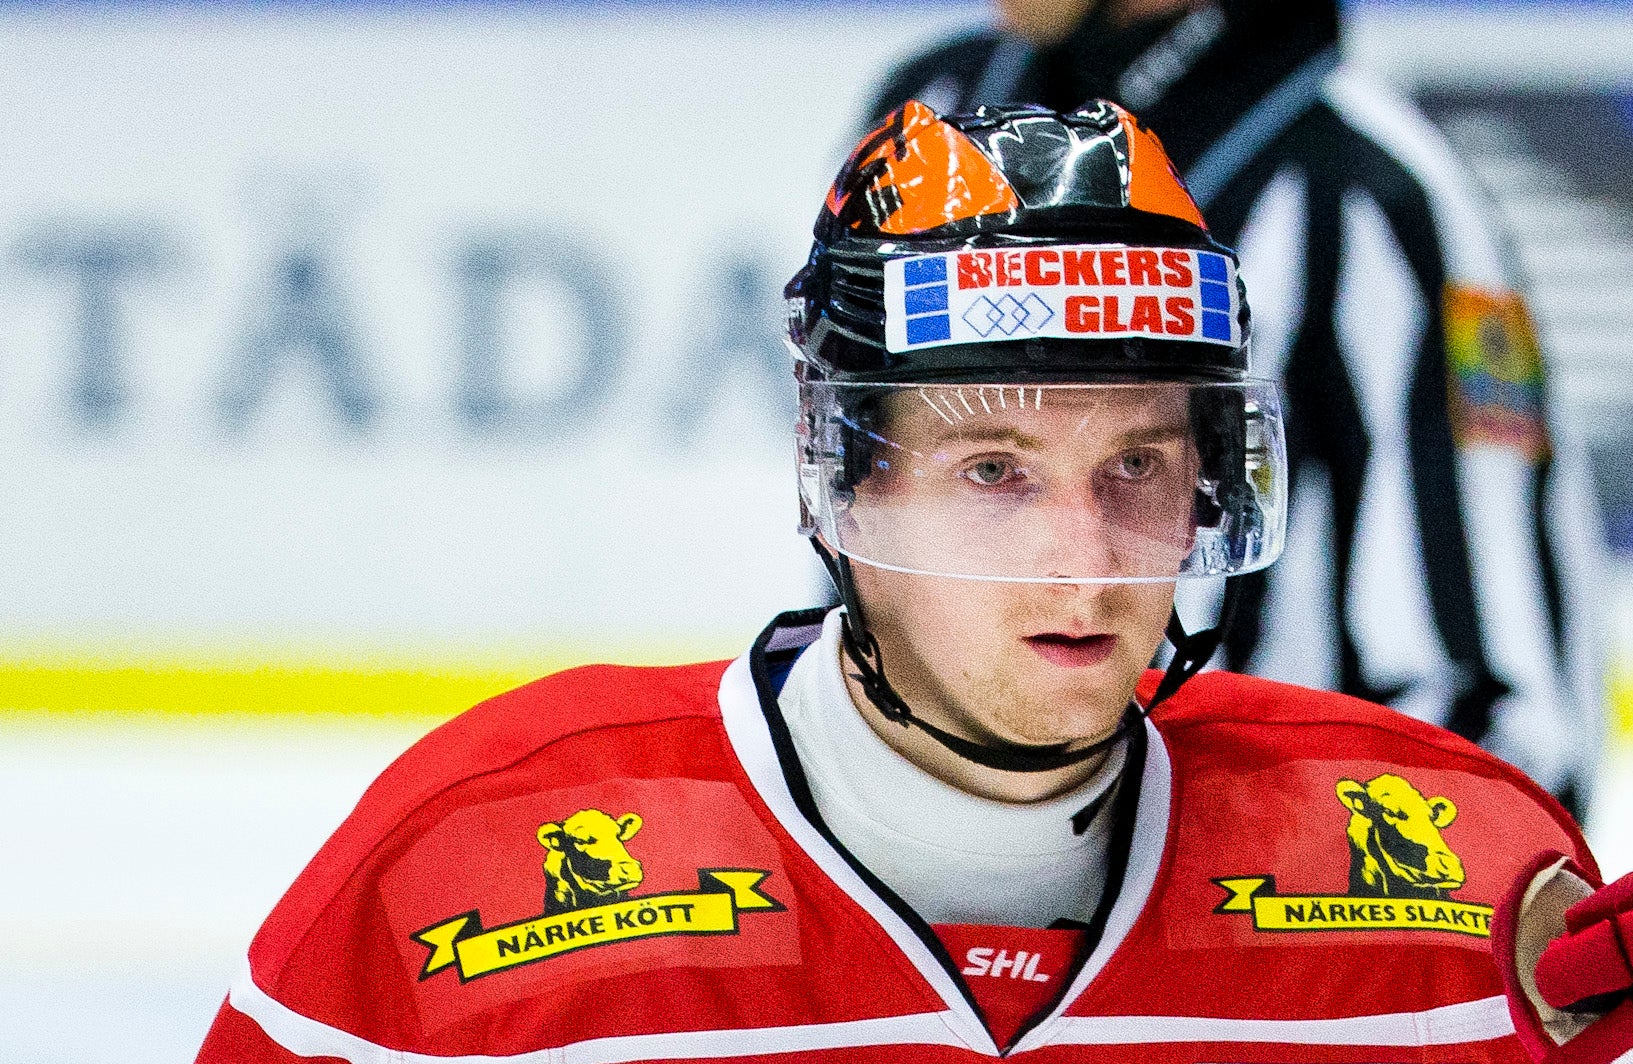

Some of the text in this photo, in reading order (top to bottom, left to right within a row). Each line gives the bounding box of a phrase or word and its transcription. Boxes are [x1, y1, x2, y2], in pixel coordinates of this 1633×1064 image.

[957, 249, 1194, 290] BECKERS
[1064, 295, 1195, 336] GLAS
[496, 901, 695, 958] NÄRKE KÖTT
[1284, 901, 1396, 924] NÄRKES
[962, 946, 1051, 982] SHL
